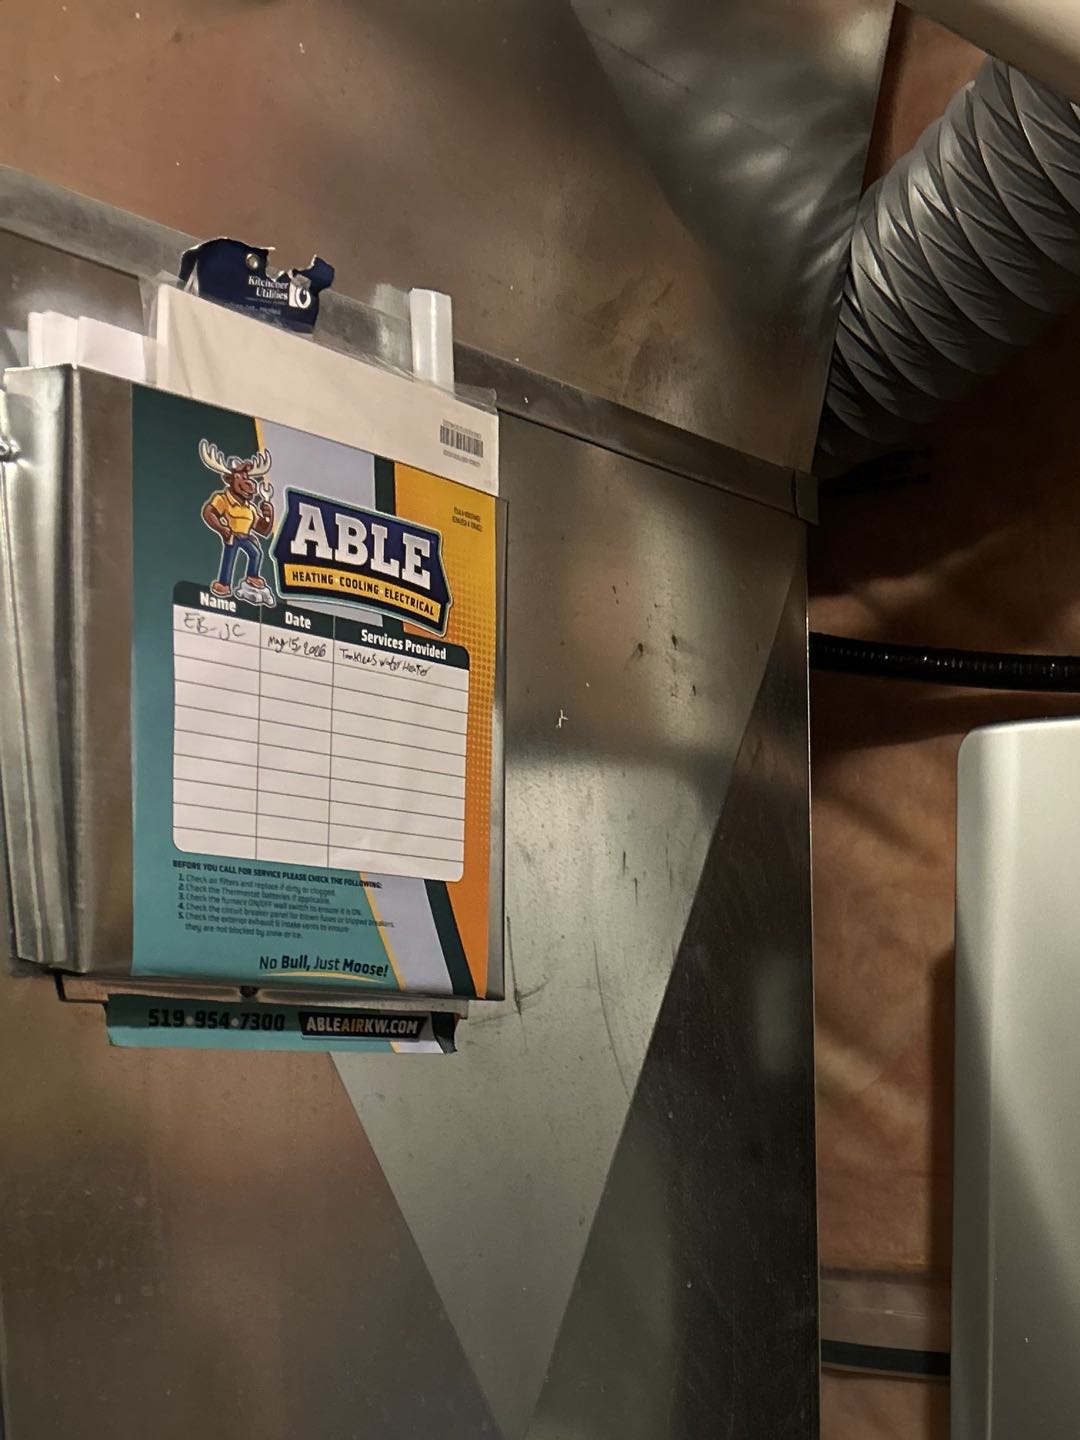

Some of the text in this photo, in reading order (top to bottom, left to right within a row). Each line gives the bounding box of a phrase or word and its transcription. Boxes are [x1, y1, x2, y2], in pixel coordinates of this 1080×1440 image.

[290, 502, 431, 590] ABLE
[292, 571, 434, 616] HEATING COOLING ELECTRICAL
[200, 591, 447, 660] Name Date Services Provided
[173, 860, 201, 871] BEFORE
[203, 863, 218, 872] YOU
[219, 865, 236, 874] CALL
[238, 867, 252, 875] FOR
[253, 868, 281, 879] SERVICE
[282, 871, 306, 881] PLEASE
[307, 874, 329, 883] CHECK
[331, 876, 342, 885] THE
[259, 955, 388, 977] No Bull, Just Moose!
[306, 1015, 418, 1034] ABLEAIRKW.COM
